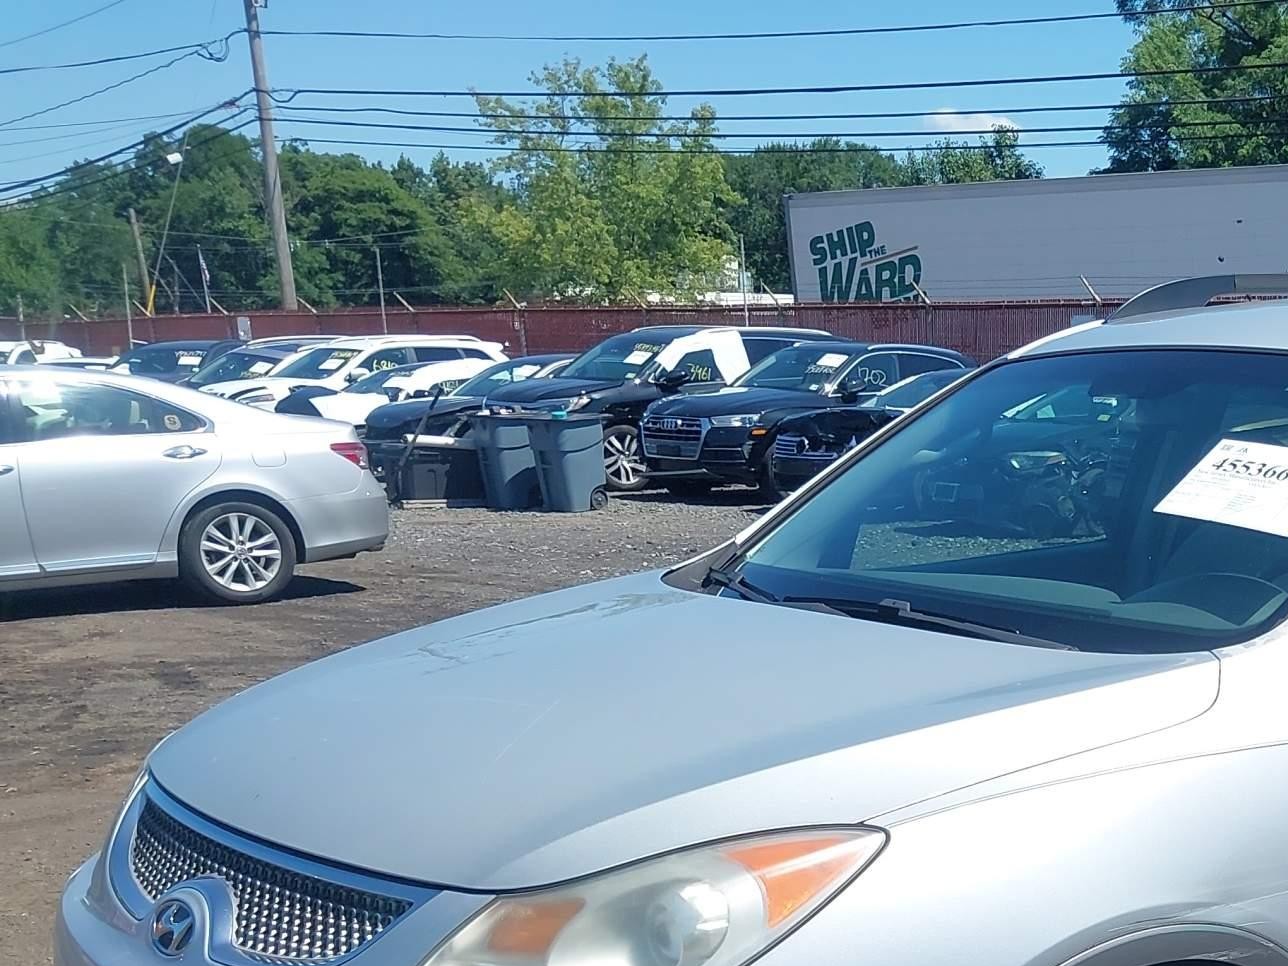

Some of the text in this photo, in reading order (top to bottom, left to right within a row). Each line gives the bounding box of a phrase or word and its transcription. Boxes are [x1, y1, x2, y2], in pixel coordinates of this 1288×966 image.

[809, 220, 876, 266] SHIP
[868, 245, 888, 259] THE
[818, 253, 923, 303] WARD
